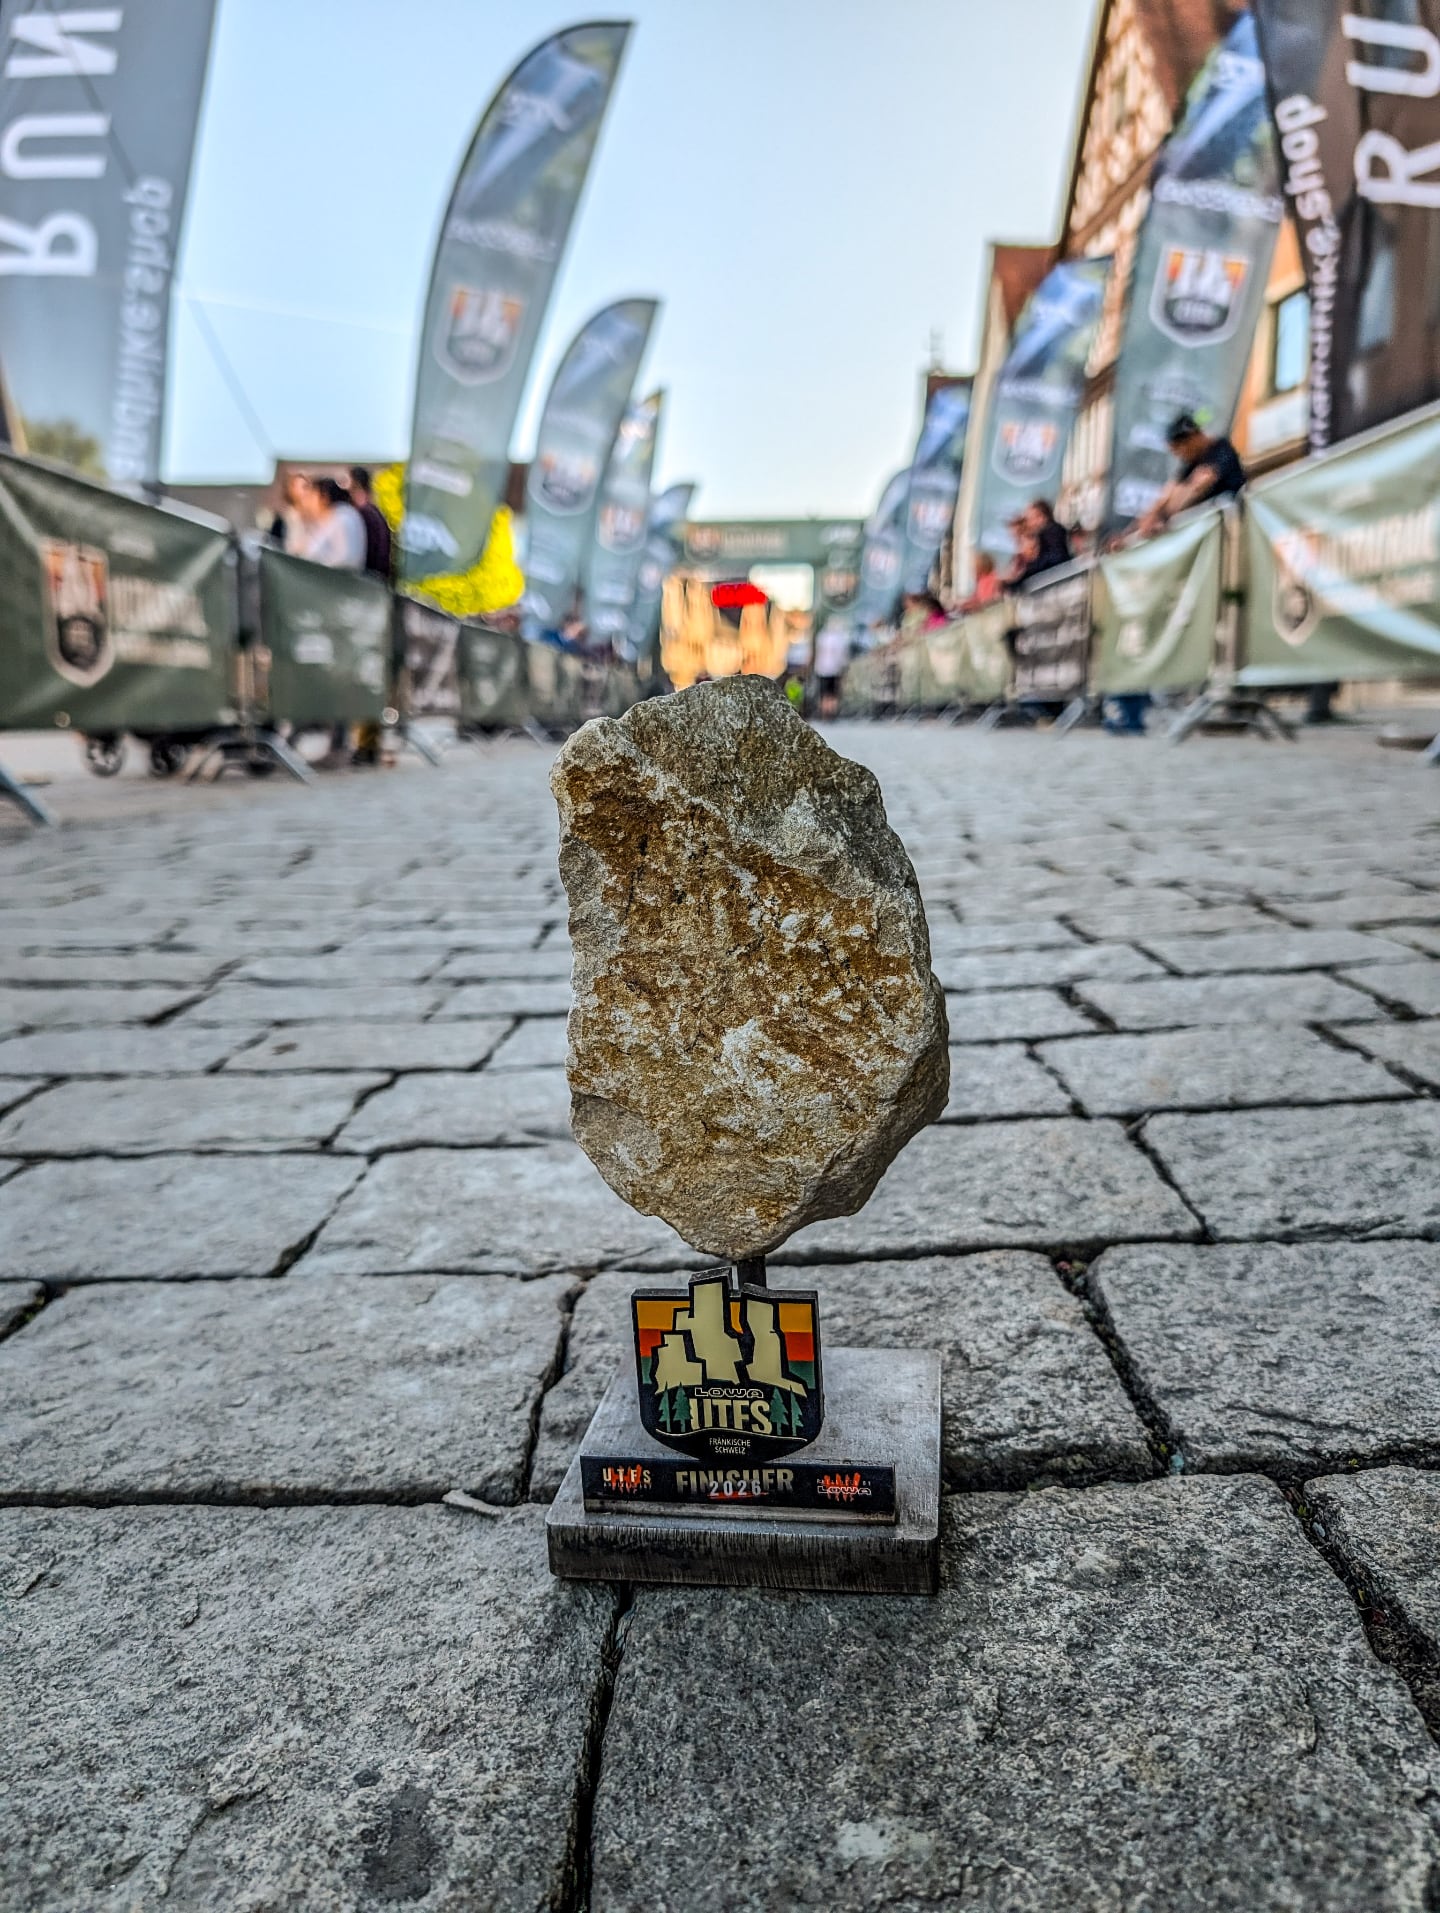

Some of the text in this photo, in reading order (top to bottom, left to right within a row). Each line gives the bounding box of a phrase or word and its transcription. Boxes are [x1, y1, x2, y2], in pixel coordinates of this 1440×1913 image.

[694, 1387, 764, 1398] LOWA
[714, 1446, 746, 1454] SCHWEIZ
[602, 1467, 652, 1483] UTFS
[709, 1479, 762, 1497] 2026
[817, 1485, 872, 1496] LOWA
